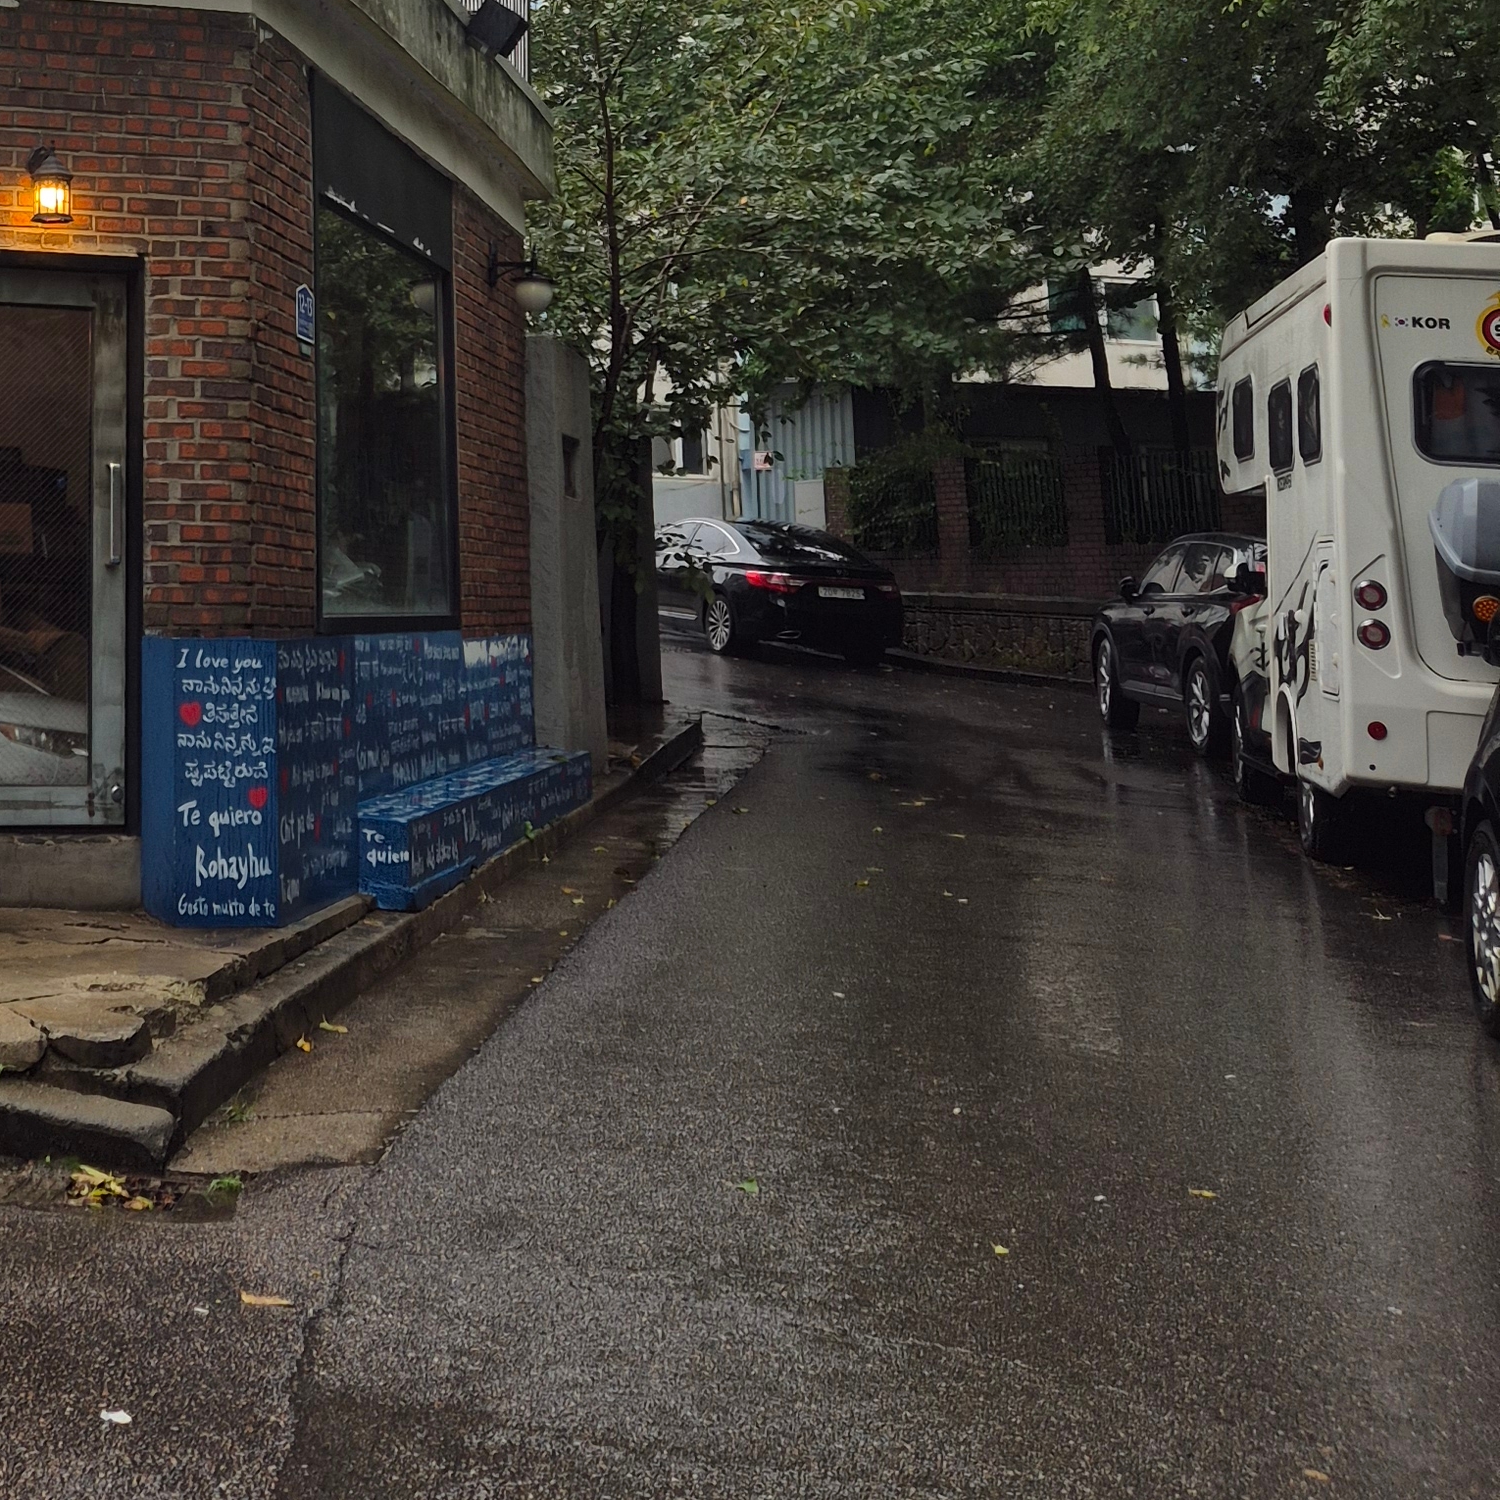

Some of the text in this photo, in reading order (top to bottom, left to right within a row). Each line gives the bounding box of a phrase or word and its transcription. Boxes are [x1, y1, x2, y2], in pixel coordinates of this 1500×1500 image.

[298, 292, 313, 317] 12-13
[1411, 316, 1451, 330] KOR
[176, 648, 189, 668] I
[195, 649, 229, 668] love
[232, 657, 263, 673] you
[177, 800, 201, 827] Te
[208, 806, 263, 838] quiero
[362, 828, 385, 843] Te
[195, 842, 272, 890] Rohayhu
[248, 896, 261, 917] de
[264, 897, 276, 918] te
